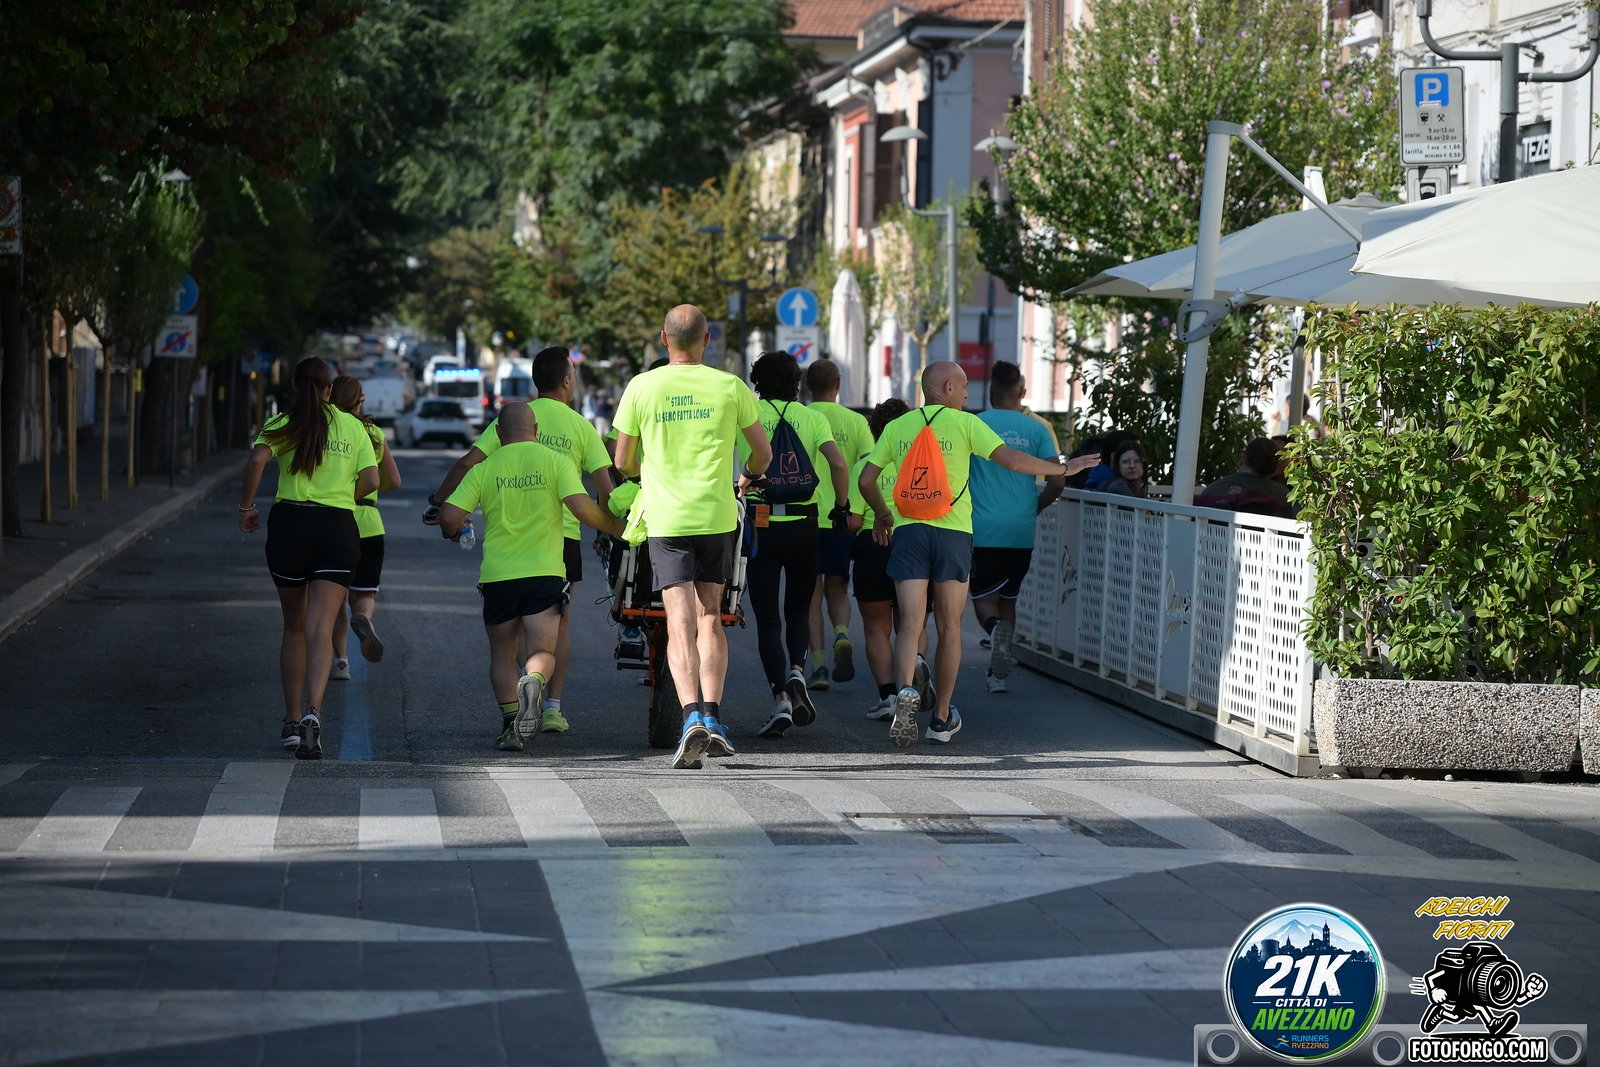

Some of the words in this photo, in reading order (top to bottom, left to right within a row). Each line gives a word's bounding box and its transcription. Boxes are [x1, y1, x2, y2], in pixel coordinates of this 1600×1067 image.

[1423, 78, 1442, 102] P
[496, 470, 546, 493] postaccio
[900, 490, 942, 500] GIVOVA
